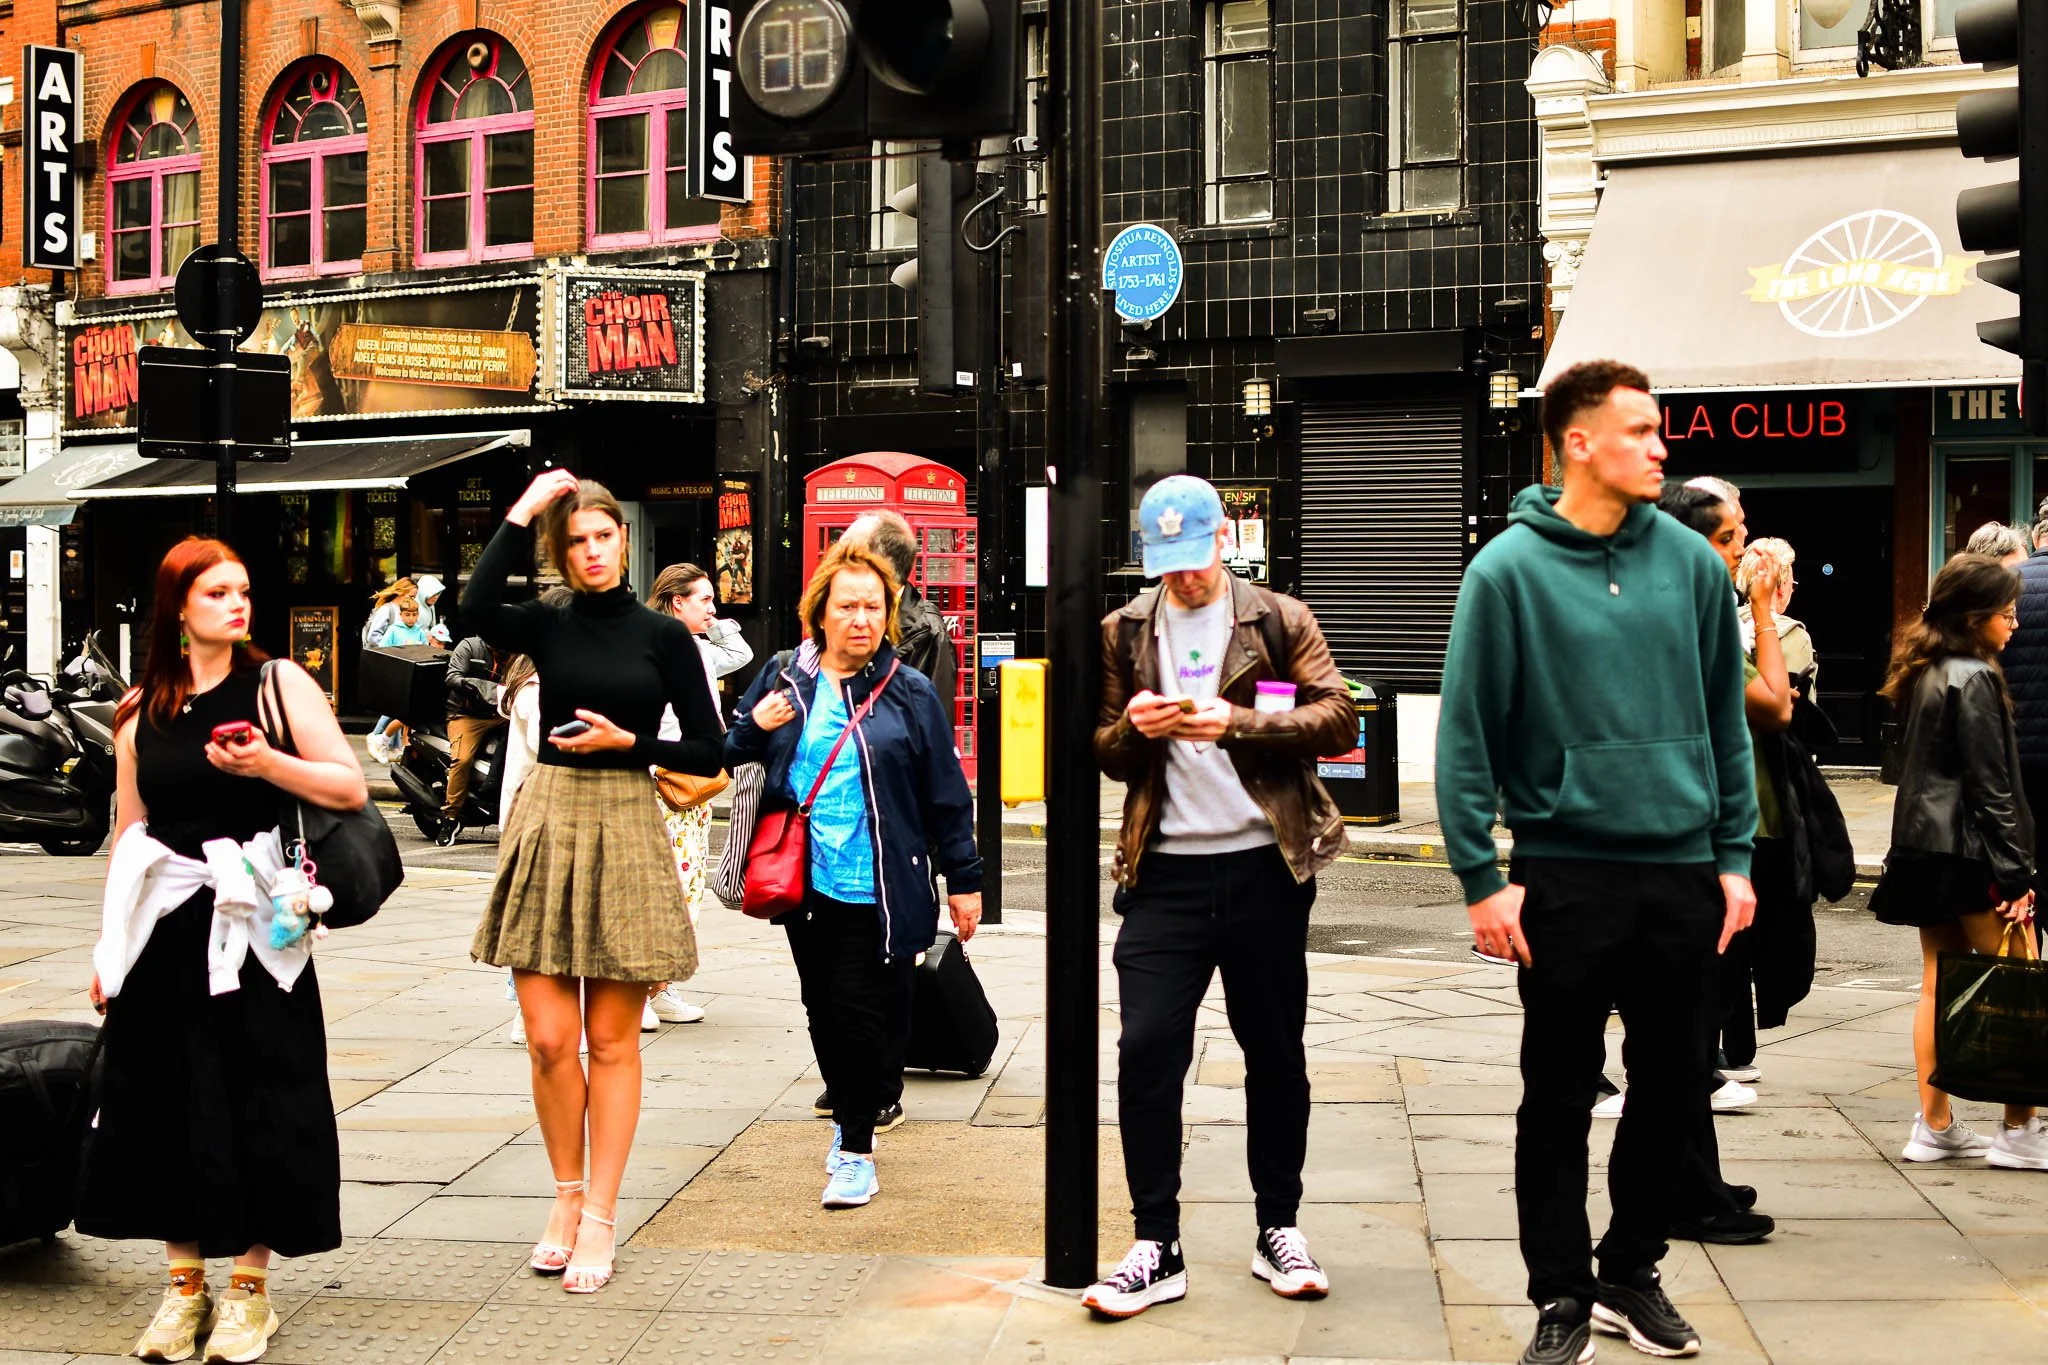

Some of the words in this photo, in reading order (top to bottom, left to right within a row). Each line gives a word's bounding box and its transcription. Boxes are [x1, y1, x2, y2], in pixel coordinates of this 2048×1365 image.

[38, 62, 72, 254] ARTS
[1109, 232, 1142, 269] JOSHUA
[1144, 231, 1178, 284] REYNOLDS
[1121, 253, 1162, 268] ARTIST
[1107, 270, 1116, 289] SIR
[1118, 273, 1165, 289] 1753-1761
[1767, 277, 1809, 298] THE
[1818, 263, 1881, 288] LONG
[600, 291, 623, 300] THE
[1116, 293, 1143, 316] LIVED
[1145, 290, 1171, 315] HERE
[584, 294, 670, 326] CHOIR
[85, 326, 101, 336] THE
[626, 320, 641, 328] OF
[382, 328, 410, 341] Featuring
[410, 330, 422, 340] hits
[457, 333, 473, 343] such
[73, 324, 135, 366] CHOIR
[381, 340, 408, 353] LUTHER
[462, 345, 481, 357] PAUL
[586, 320, 677, 375] MAN
[102, 355, 114, 365] OF
[377, 353, 397, 365] GUNS
[397, 354, 403, 365] &
[451, 360, 463, 369] and
[463, 359, 482, 371] KATY
[375, 365, 401, 377] Welcome
[409, 368, 419, 378] the
[419, 369, 433, 380] best
[433, 370, 446, 382] pub
[452, 371, 463, 381] the
[74, 353, 138, 419] MAN
[1948, 389, 2006, 420] THE
[1664, 404, 1714, 440] LA
[1731, 401, 1847, 439] CLUB
[367, 491, 398, 503] TICKETS
[457, 490, 491, 501] TICKETS
[719, 493, 749, 509] CHOIR
[821, 488, 881, 499] TELEPHONE
[906, 490, 954, 501] TELEPHONE
[719, 505, 750, 530] MAN
